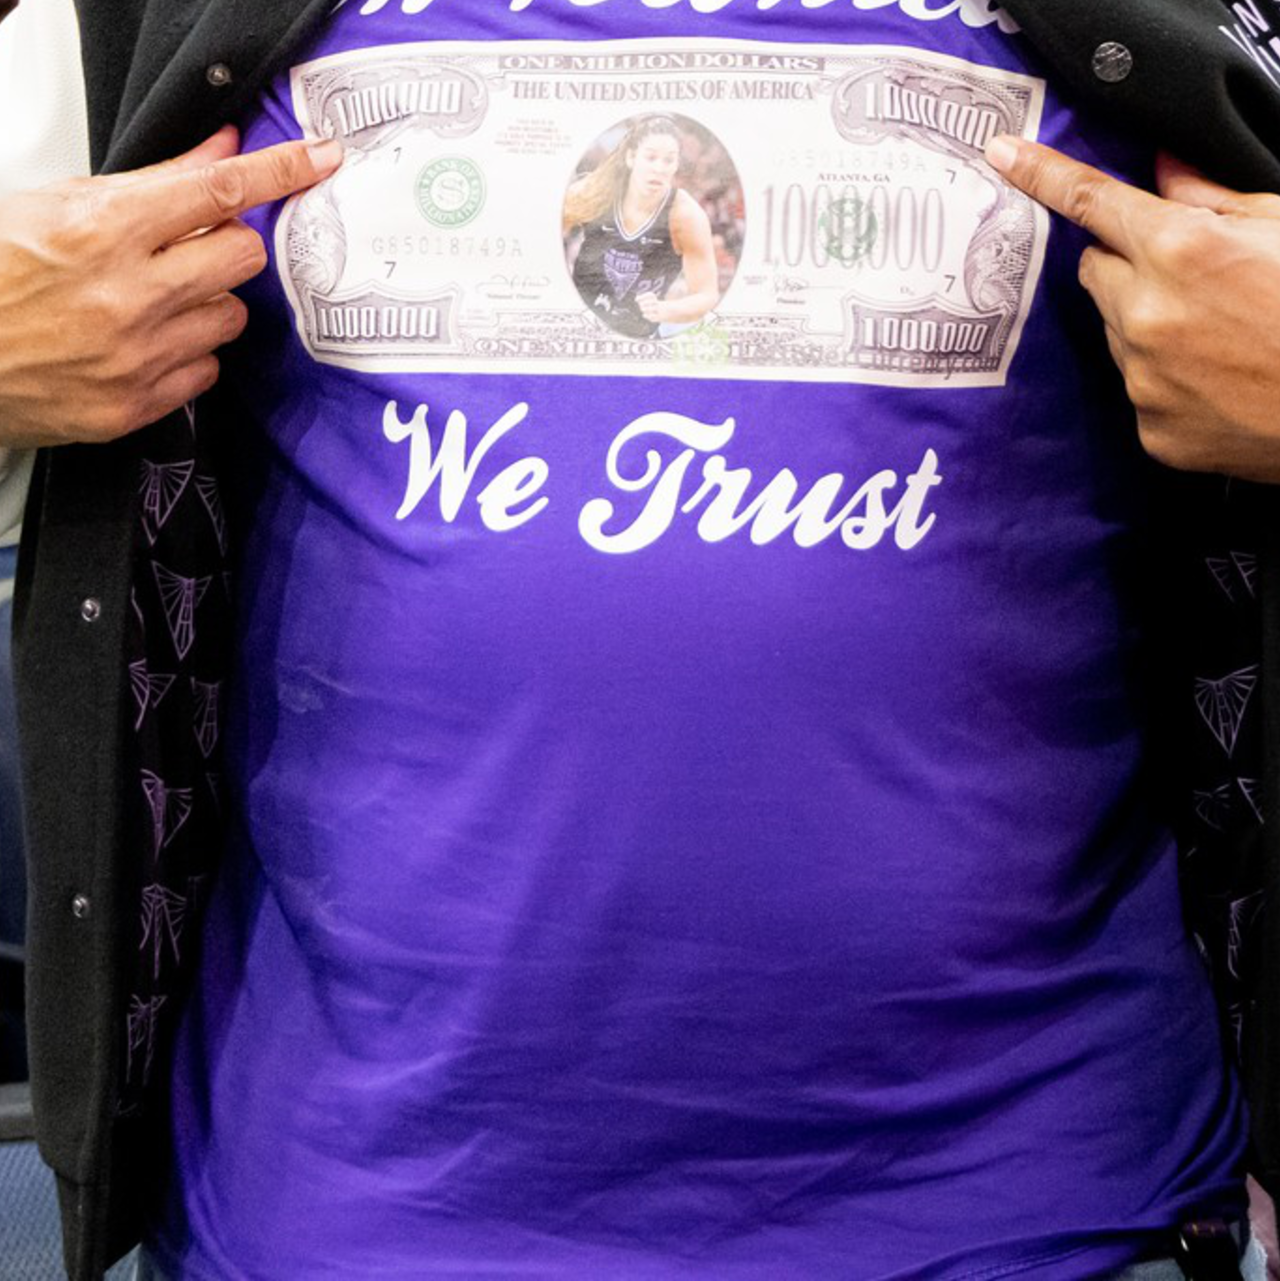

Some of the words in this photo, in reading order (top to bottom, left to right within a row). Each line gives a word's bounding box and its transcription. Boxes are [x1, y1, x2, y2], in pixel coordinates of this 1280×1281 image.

[505, 55, 565, 69] ONE
[571, 54, 688, 69] MILLION
[694, 53, 820, 71] DOLLARS
[513, 80, 549, 100] THE
[554, 81, 626, 101] UNITED
[629, 80, 700, 101] STATES
[701, 80, 726, 100] OF
[729, 80, 814, 101] AMERICA
[372, 235, 523, 259] G85018749A
[385, 261, 397, 280] 7
[944, 274, 957, 294] 7
[383, 399, 549, 532] We
[578, 412, 942, 554] Trust
